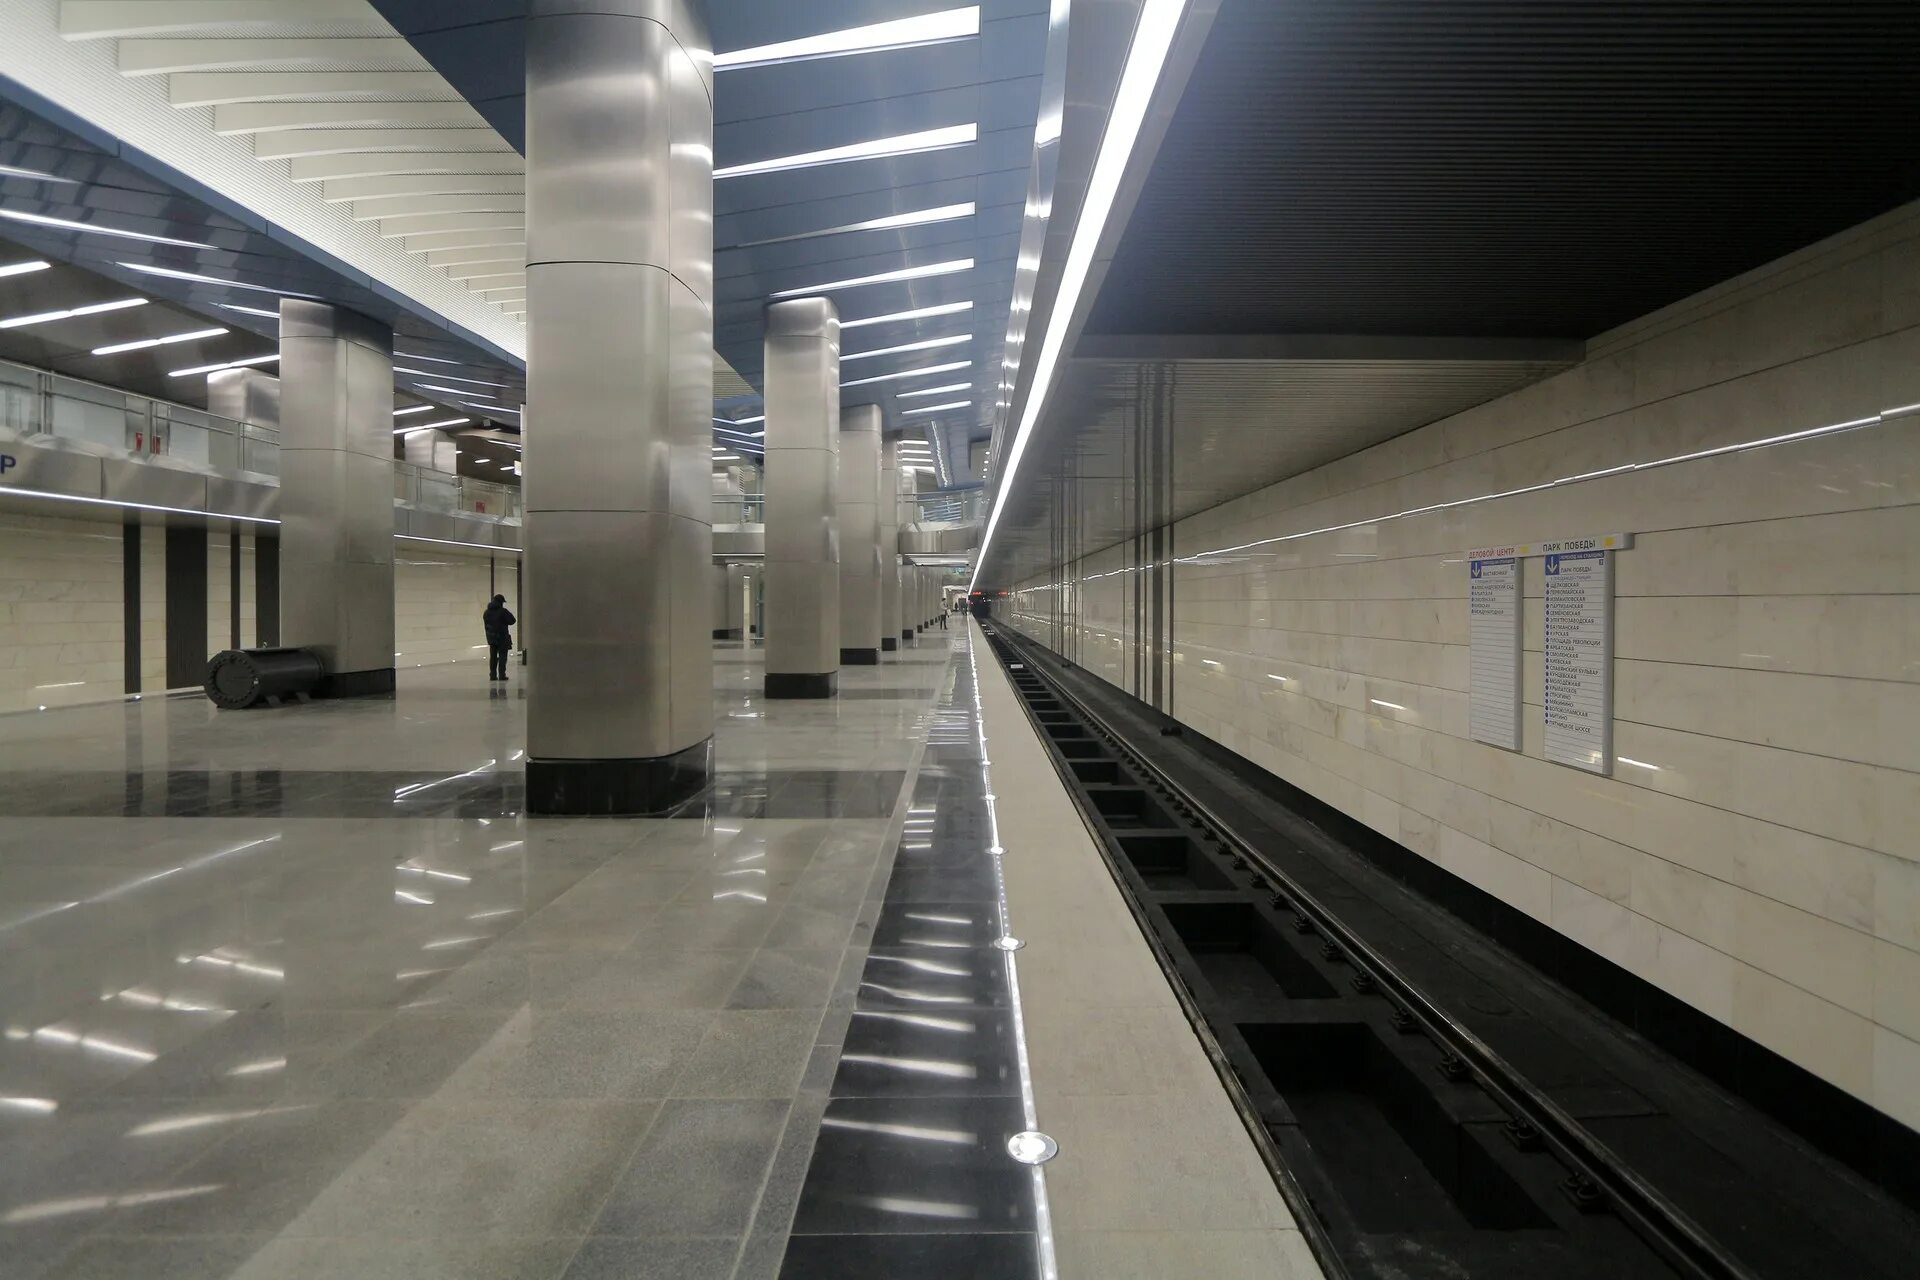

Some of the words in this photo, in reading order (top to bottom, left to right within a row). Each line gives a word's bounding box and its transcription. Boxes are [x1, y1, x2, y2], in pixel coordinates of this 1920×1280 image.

[1543, 543, 1560, 552] ПАРК
[1565, 540, 1596, 550] ПОБЕДЫ
[1468, 548, 1494, 559] ДЕЛОВОЙ
[1496, 547, 1515, 557] ЦЕНТР
